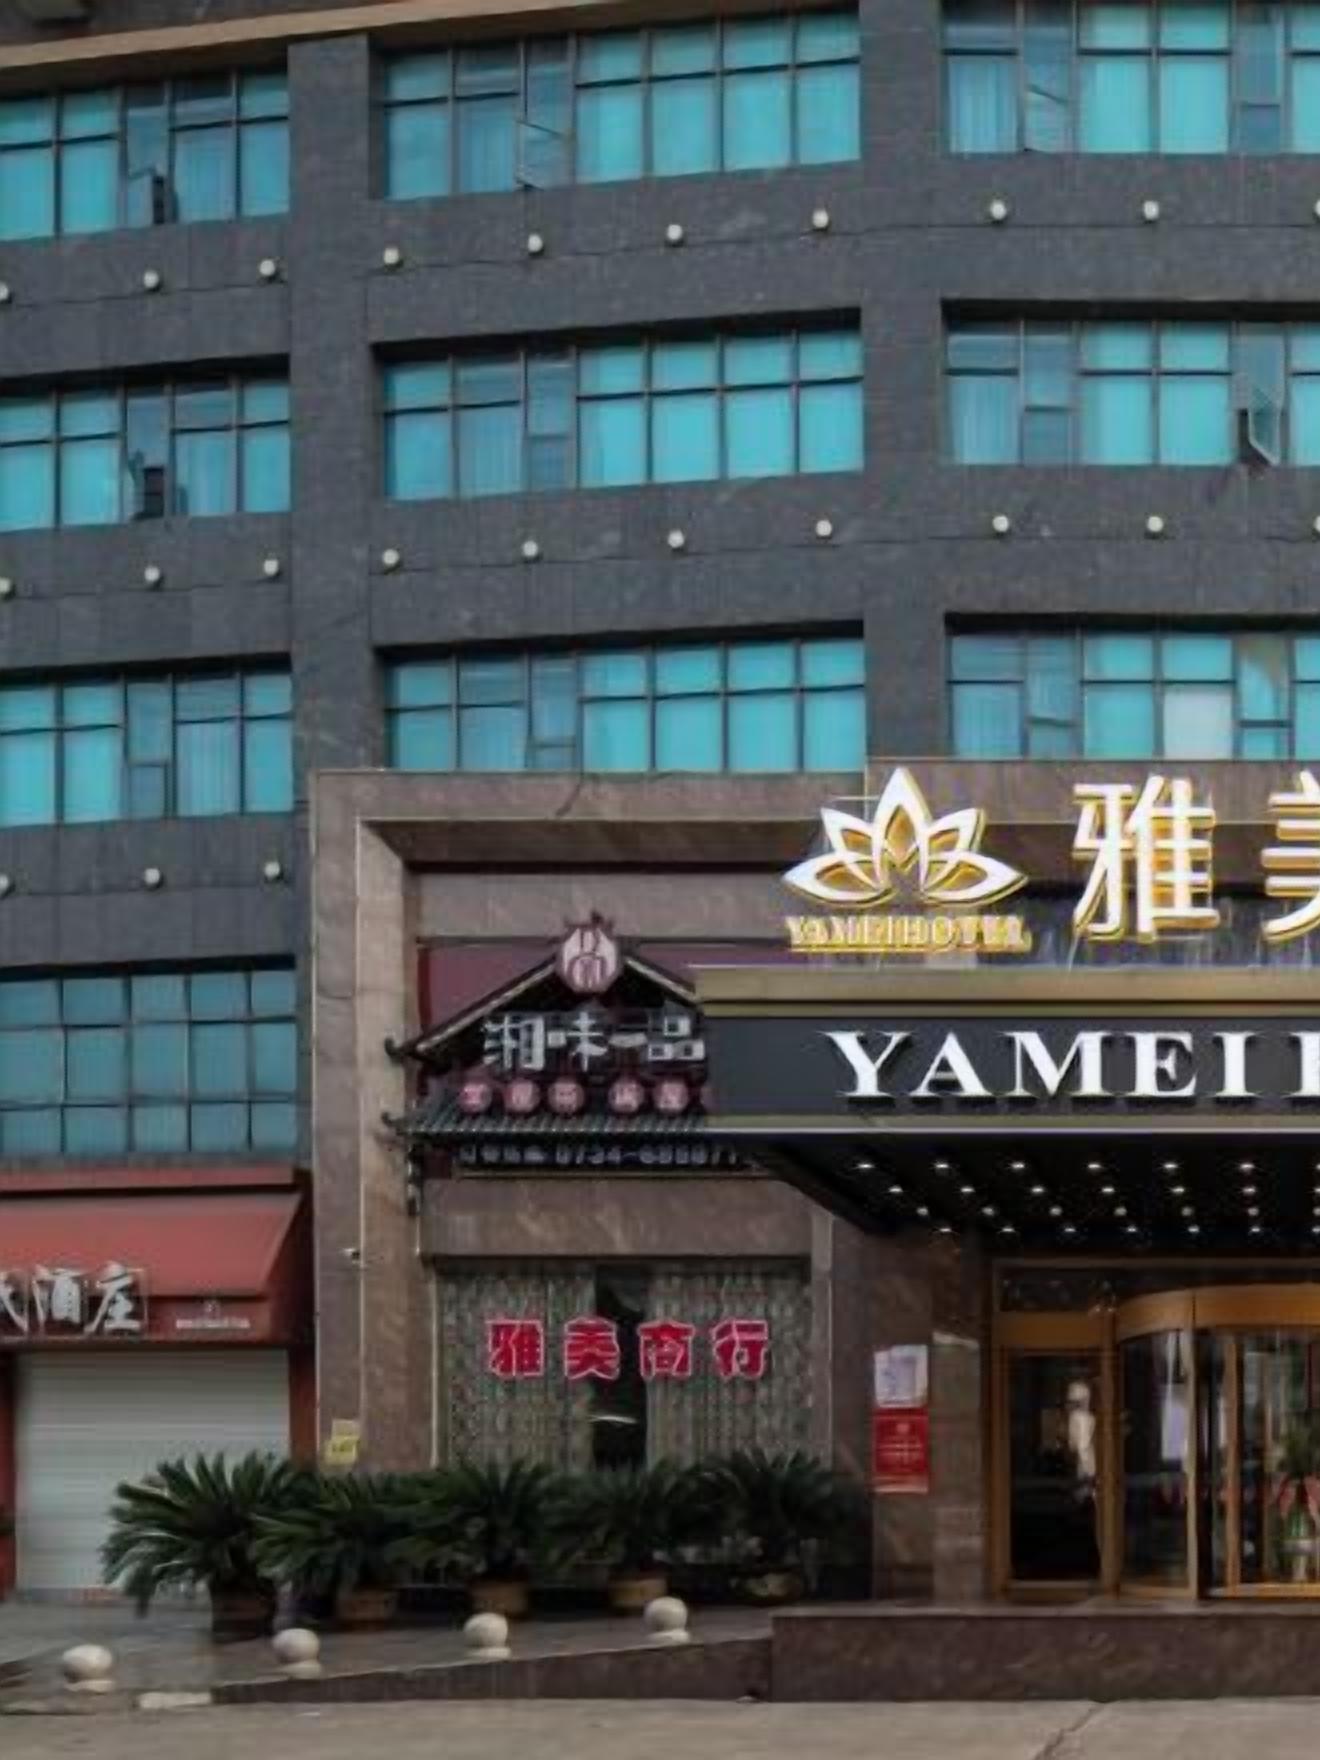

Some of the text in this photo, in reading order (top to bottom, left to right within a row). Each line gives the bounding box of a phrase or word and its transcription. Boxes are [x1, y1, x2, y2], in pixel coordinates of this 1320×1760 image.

[482, 1010, 706, 1072] 湘味一品
[824, 1030, 1255, 1099] YAMEI
[485, 1317, 768, 1380] 雅美商行
